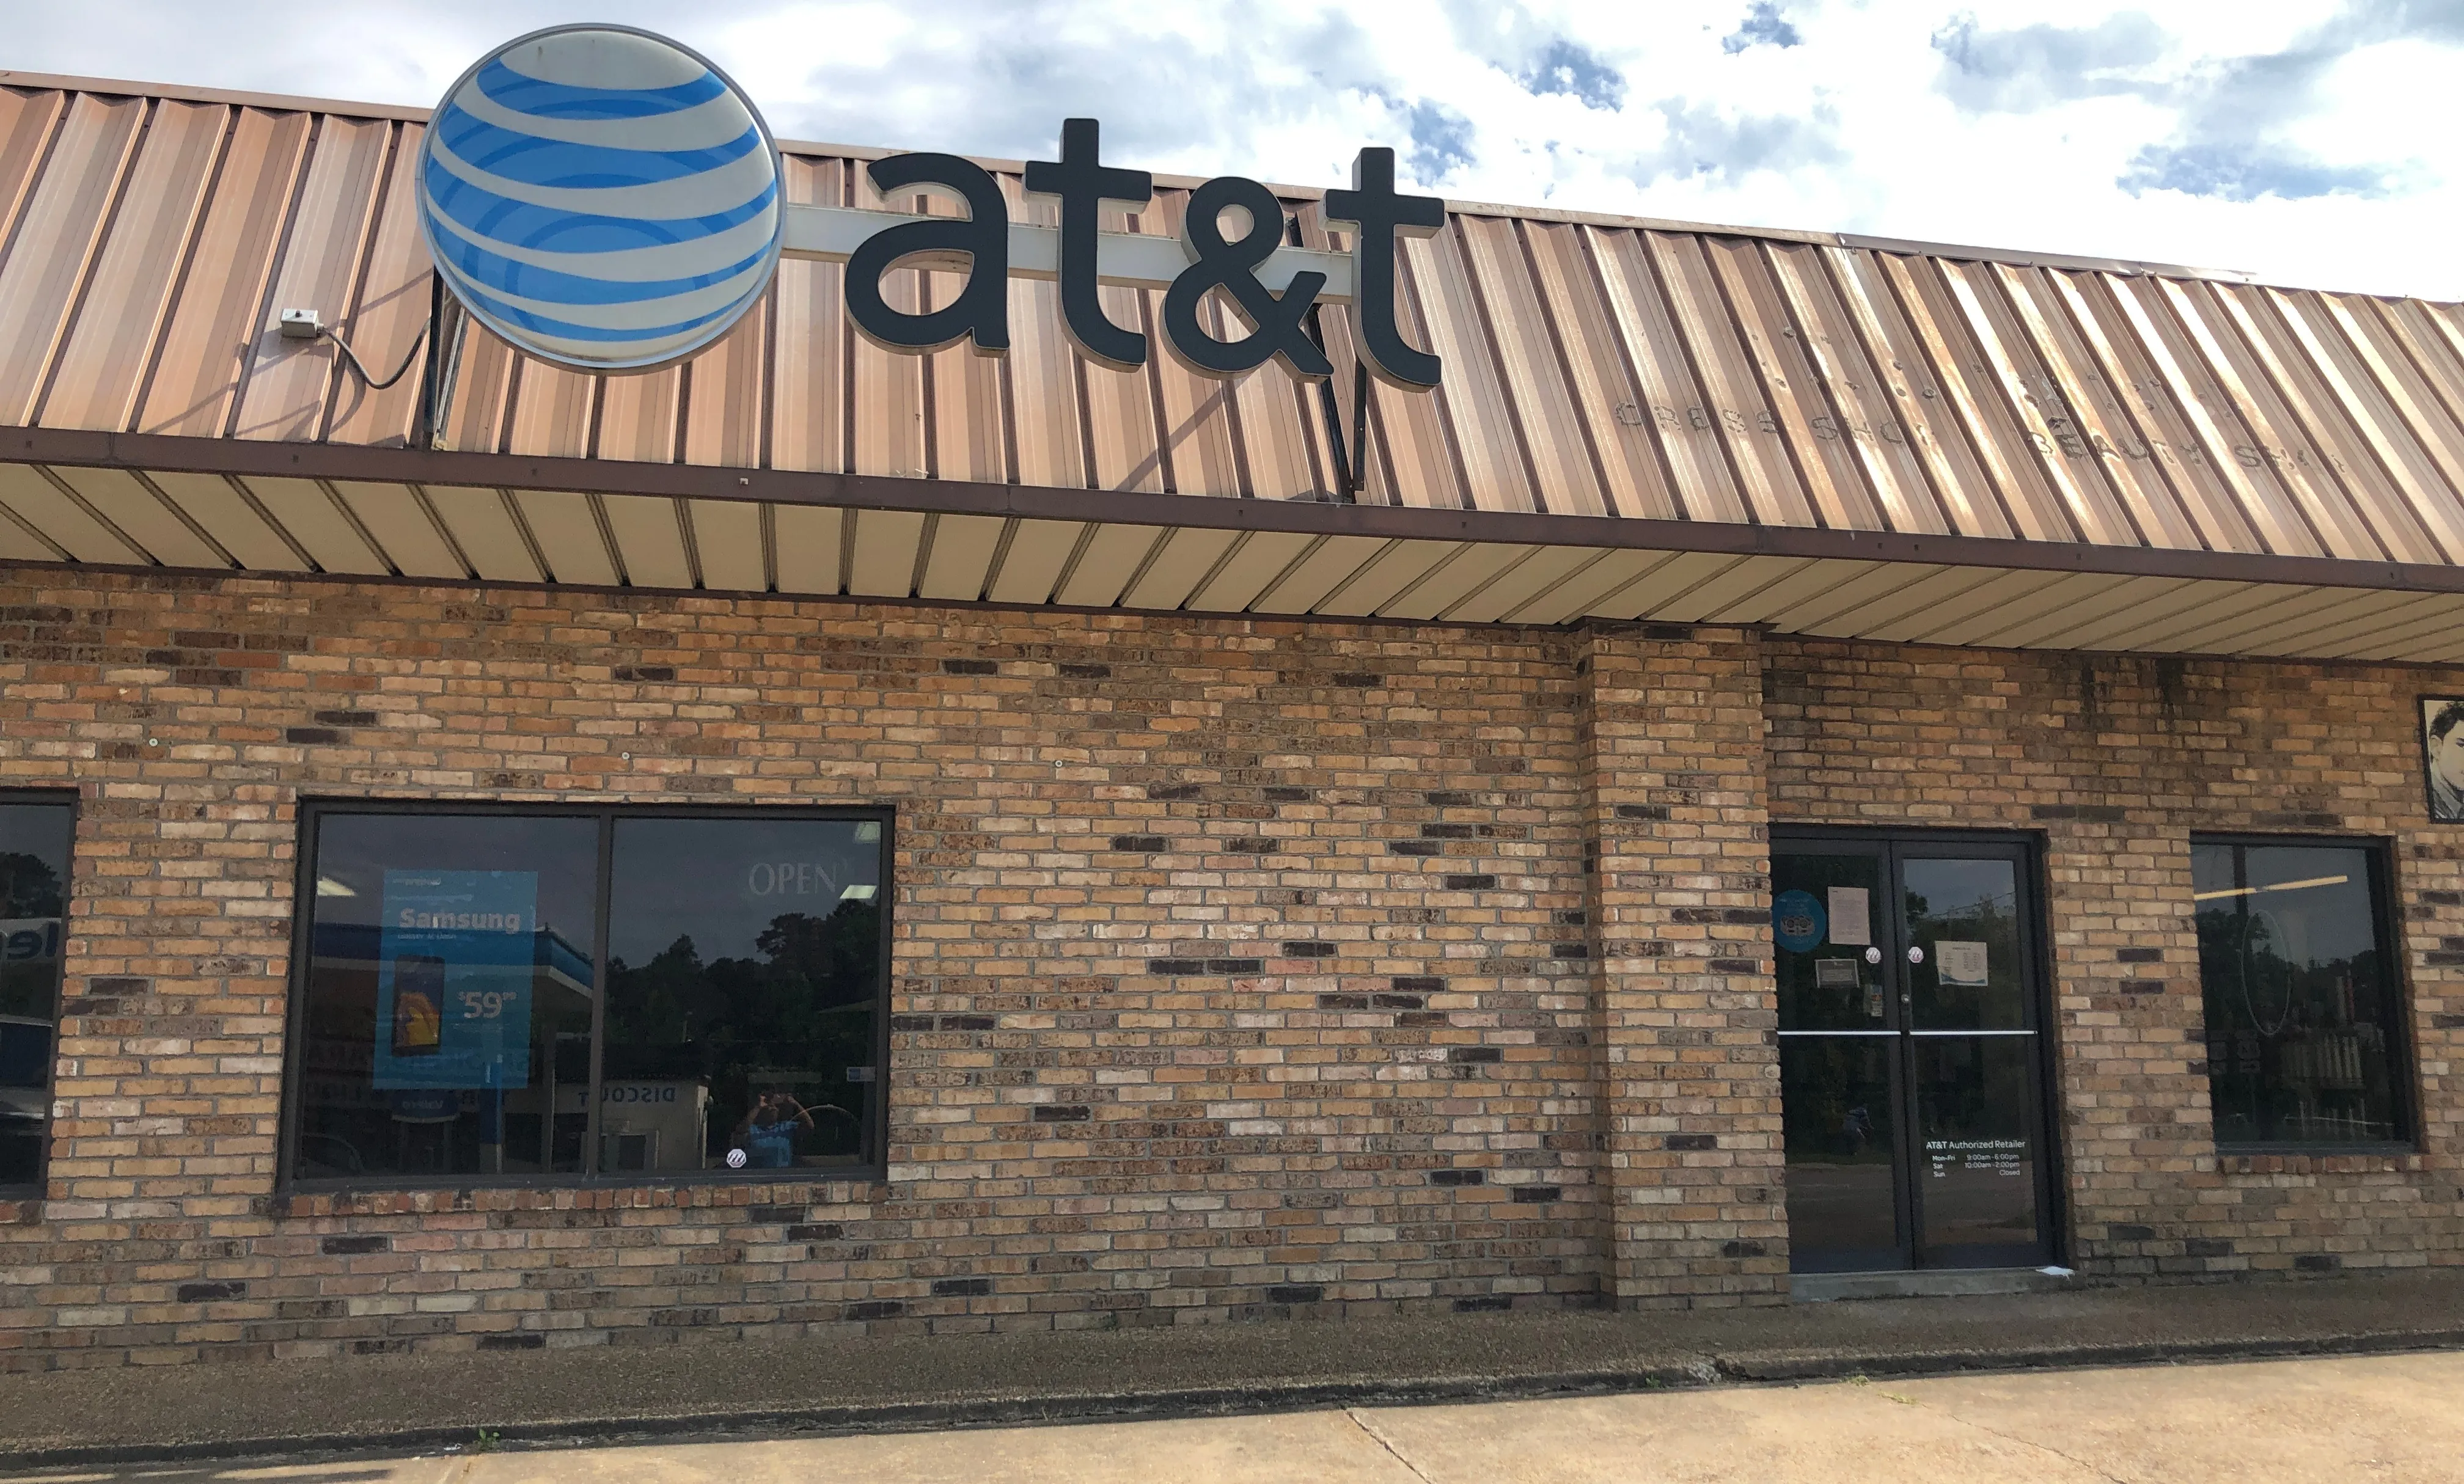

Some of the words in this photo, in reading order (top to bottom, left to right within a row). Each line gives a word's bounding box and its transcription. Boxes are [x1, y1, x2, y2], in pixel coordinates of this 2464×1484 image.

[845, 118, 1445, 392] at&t
[749, 862, 837, 896] OPEN
[399, 907, 520, 935] Samsung
[1926, 1141, 1948, 1150] AT&T
[1948, 1141, 1994, 1149] Authorized
[1995, 1140, 2026, 1149] Retailer
